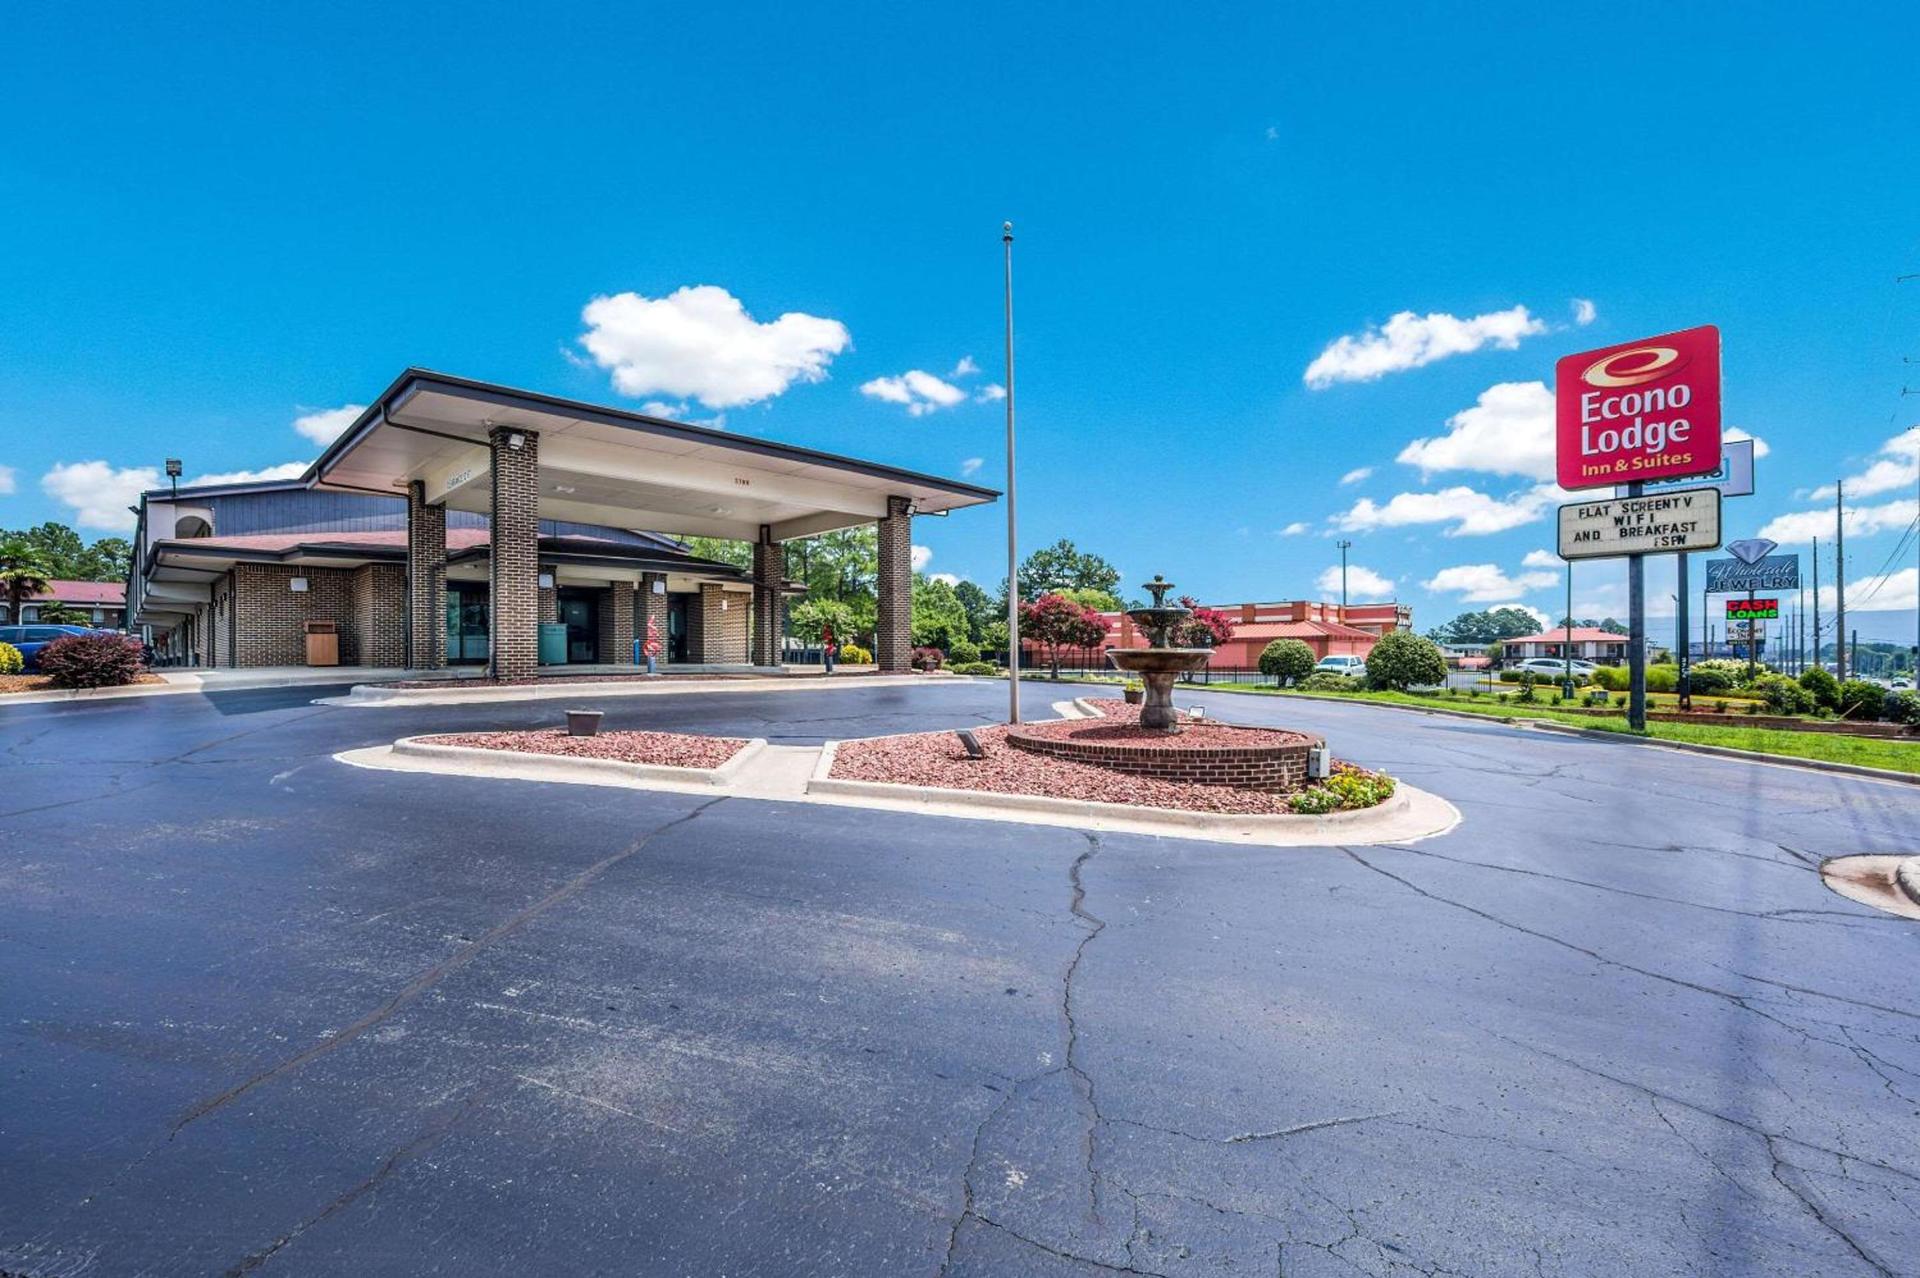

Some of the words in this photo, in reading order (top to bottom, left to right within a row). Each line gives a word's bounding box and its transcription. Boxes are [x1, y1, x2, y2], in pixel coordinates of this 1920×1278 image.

[1581, 384, 1691, 424] Econo
[1581, 416, 1691, 455] Lodge
[1582, 464, 1611, 477] Inn
[1615, 459, 1628, 472] &
[1632, 453, 1692, 470] Suites
[1578, 505, 1610, 519] FLAT
[1573, 529, 1601, 543] AND
[1619, 522, 1697, 538] BREAKFAST
[1709, 577, 1796, 592] JEWELRY
[1727, 600, 1777, 610] CASH
[1727, 609, 1778, 619] LOANS
